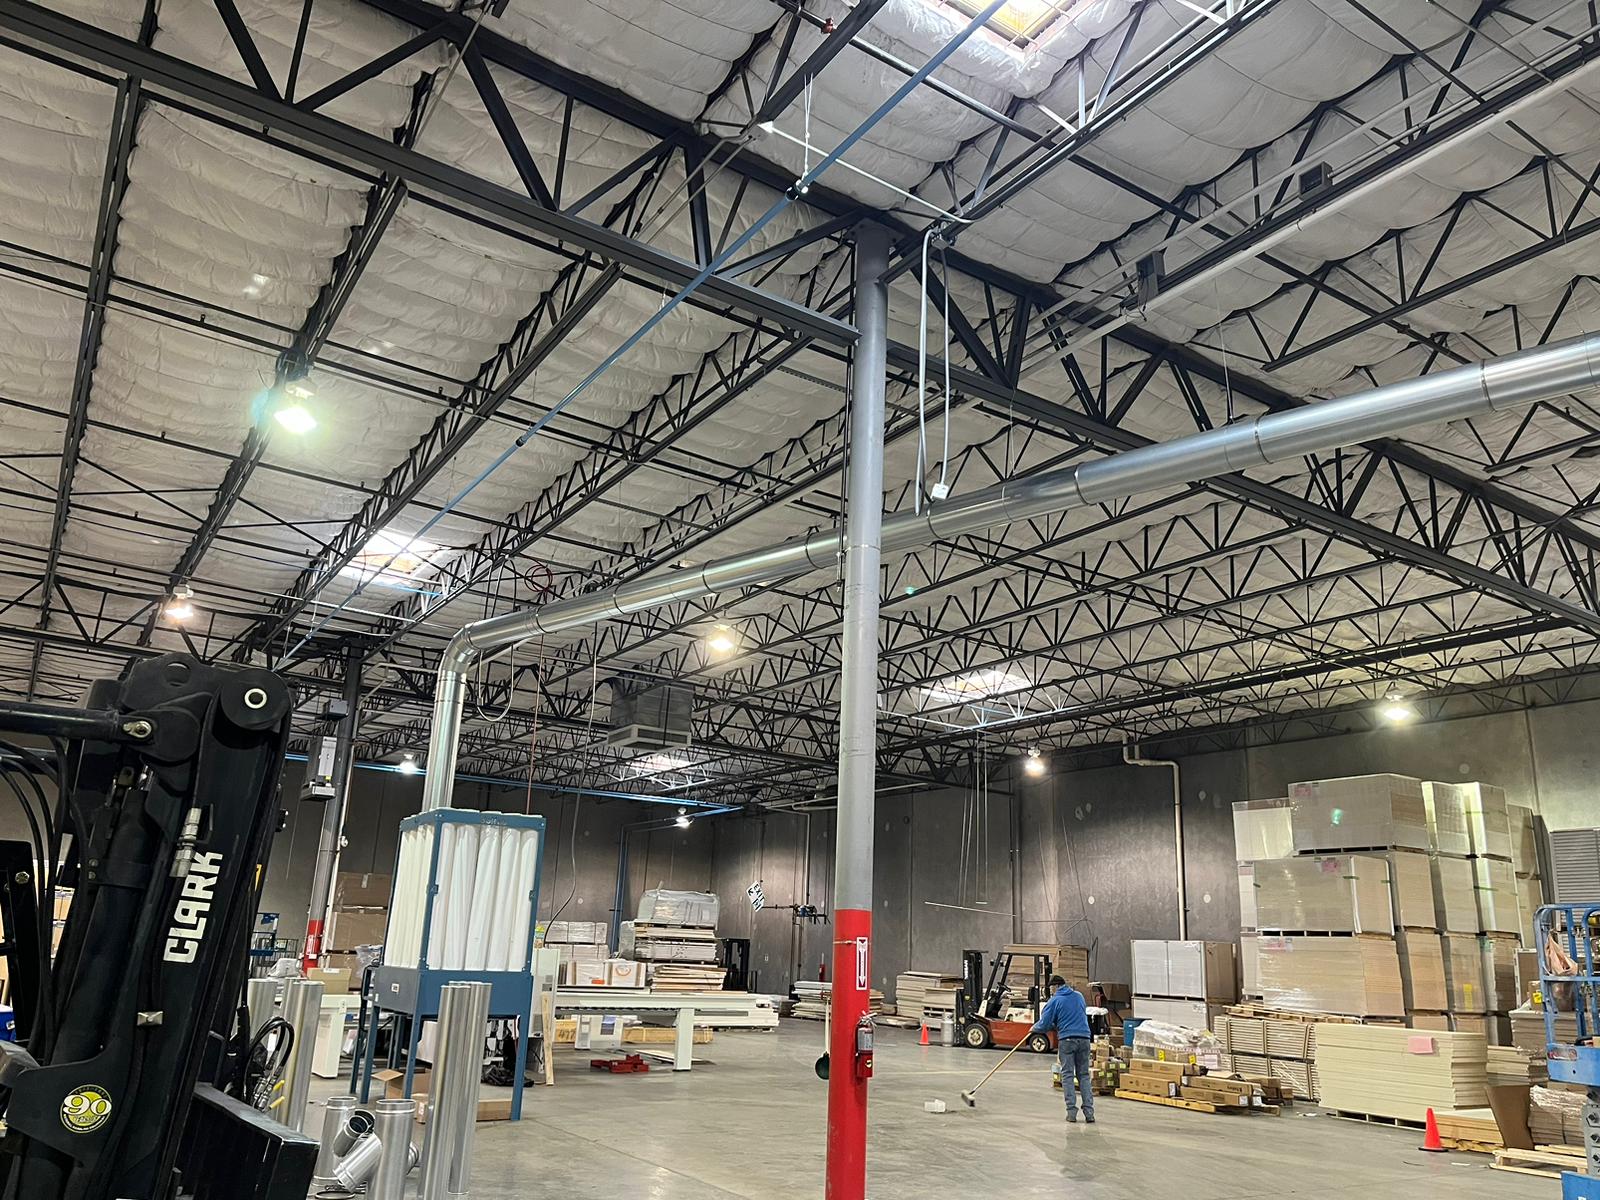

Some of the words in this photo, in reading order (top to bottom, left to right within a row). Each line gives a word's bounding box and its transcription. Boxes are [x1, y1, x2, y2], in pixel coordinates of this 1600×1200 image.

[753, 883, 766, 902] EXIT
[163, 851, 224, 964] CLARK
[63, 1094, 113, 1116] 90
